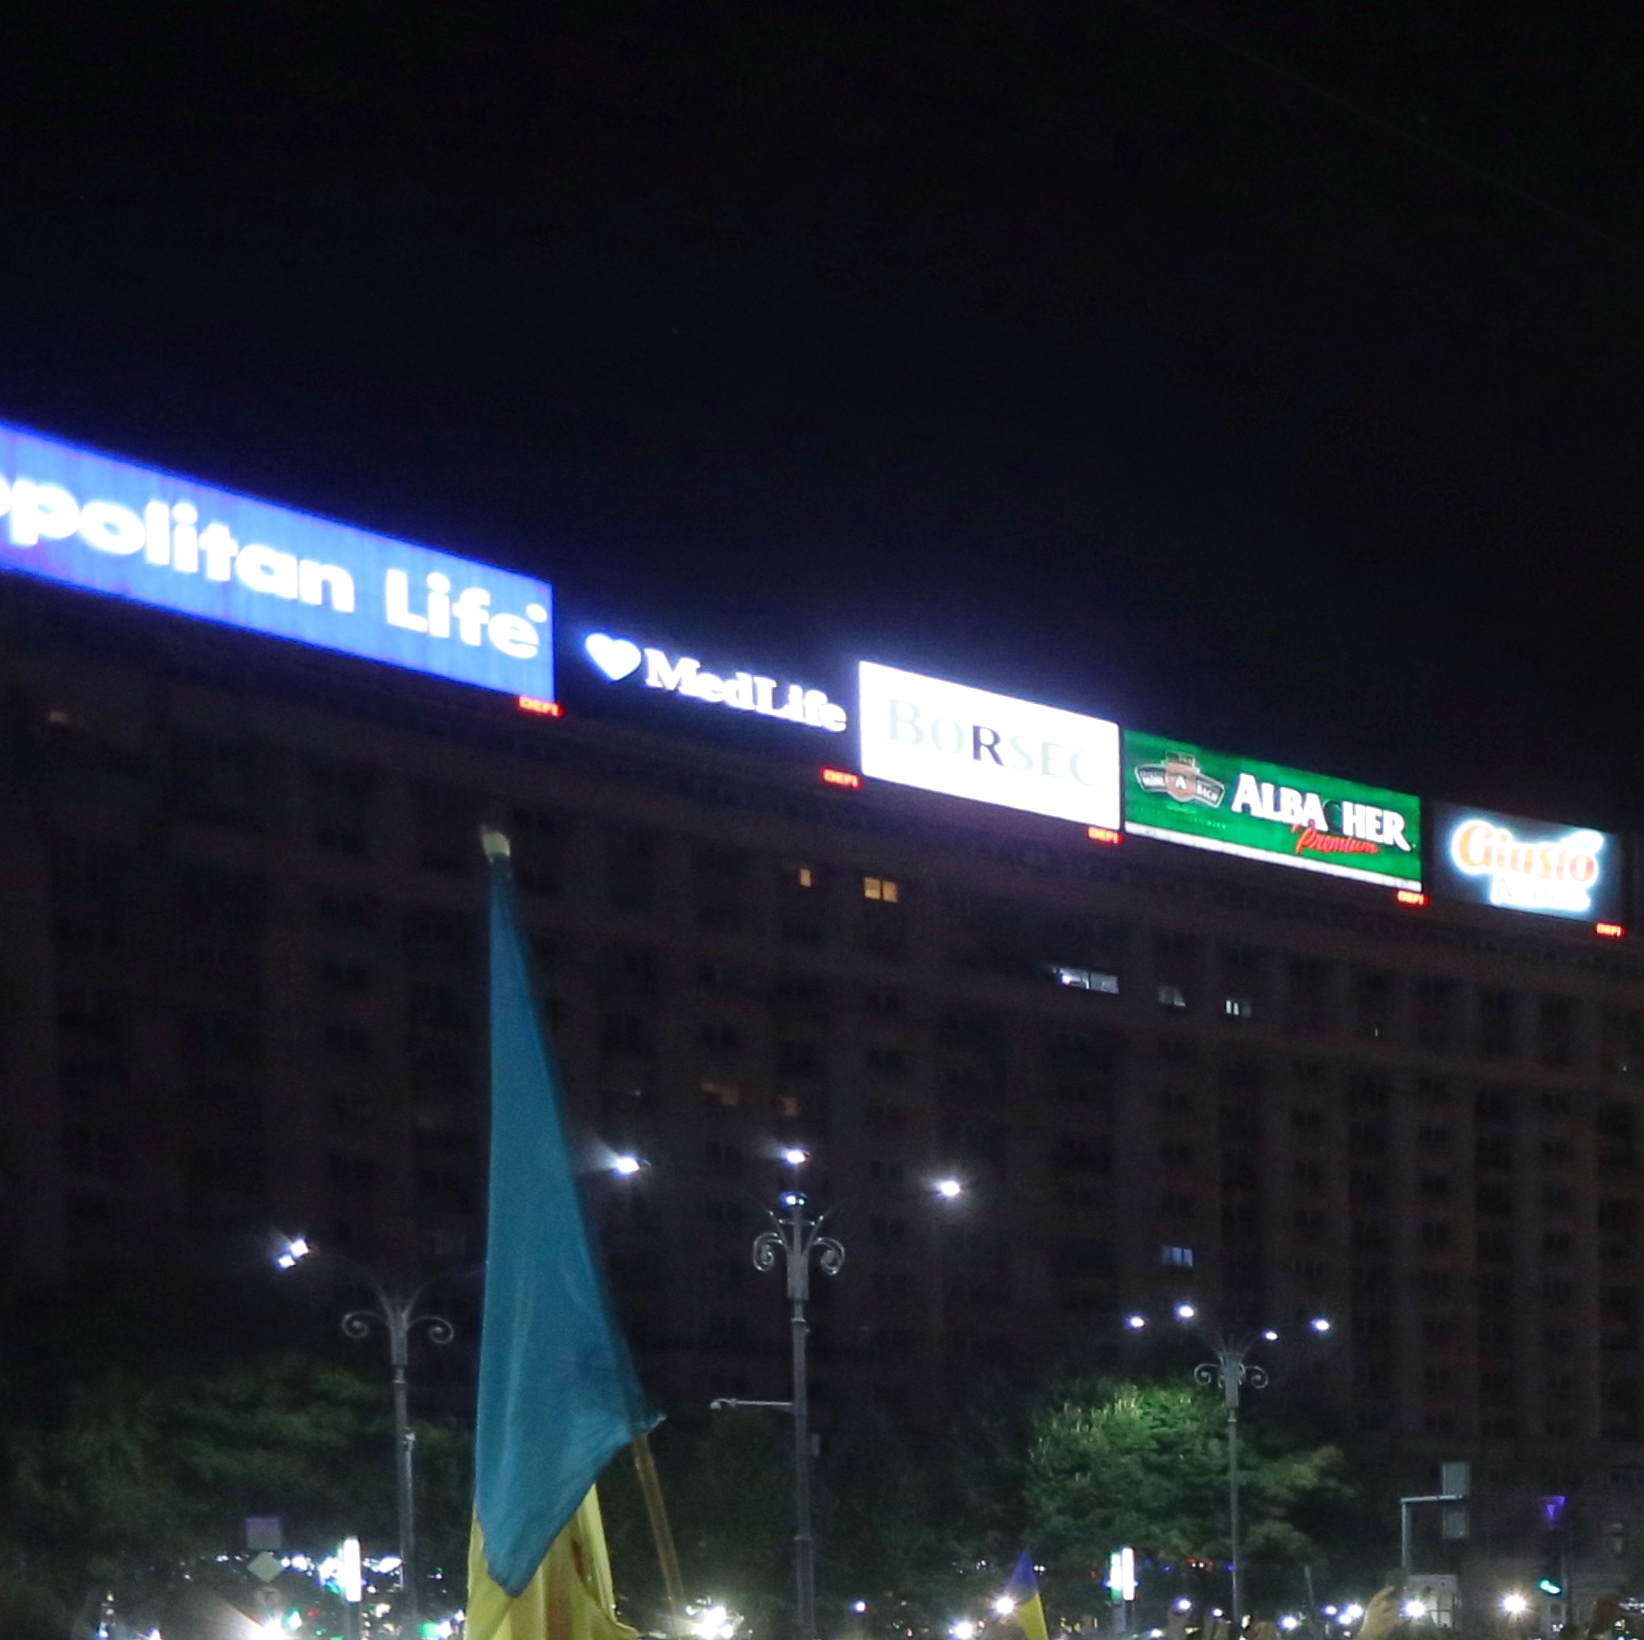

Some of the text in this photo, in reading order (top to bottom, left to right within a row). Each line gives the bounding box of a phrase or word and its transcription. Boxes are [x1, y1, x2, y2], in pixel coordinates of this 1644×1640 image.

[0, 472, 355, 614] politan
[643, 647, 848, 733] MedLife
[888, 698, 1095, 787] BORSEC
[1292, 822, 1380, 855] Premium
[1459, 823, 1595, 882] Giusto
